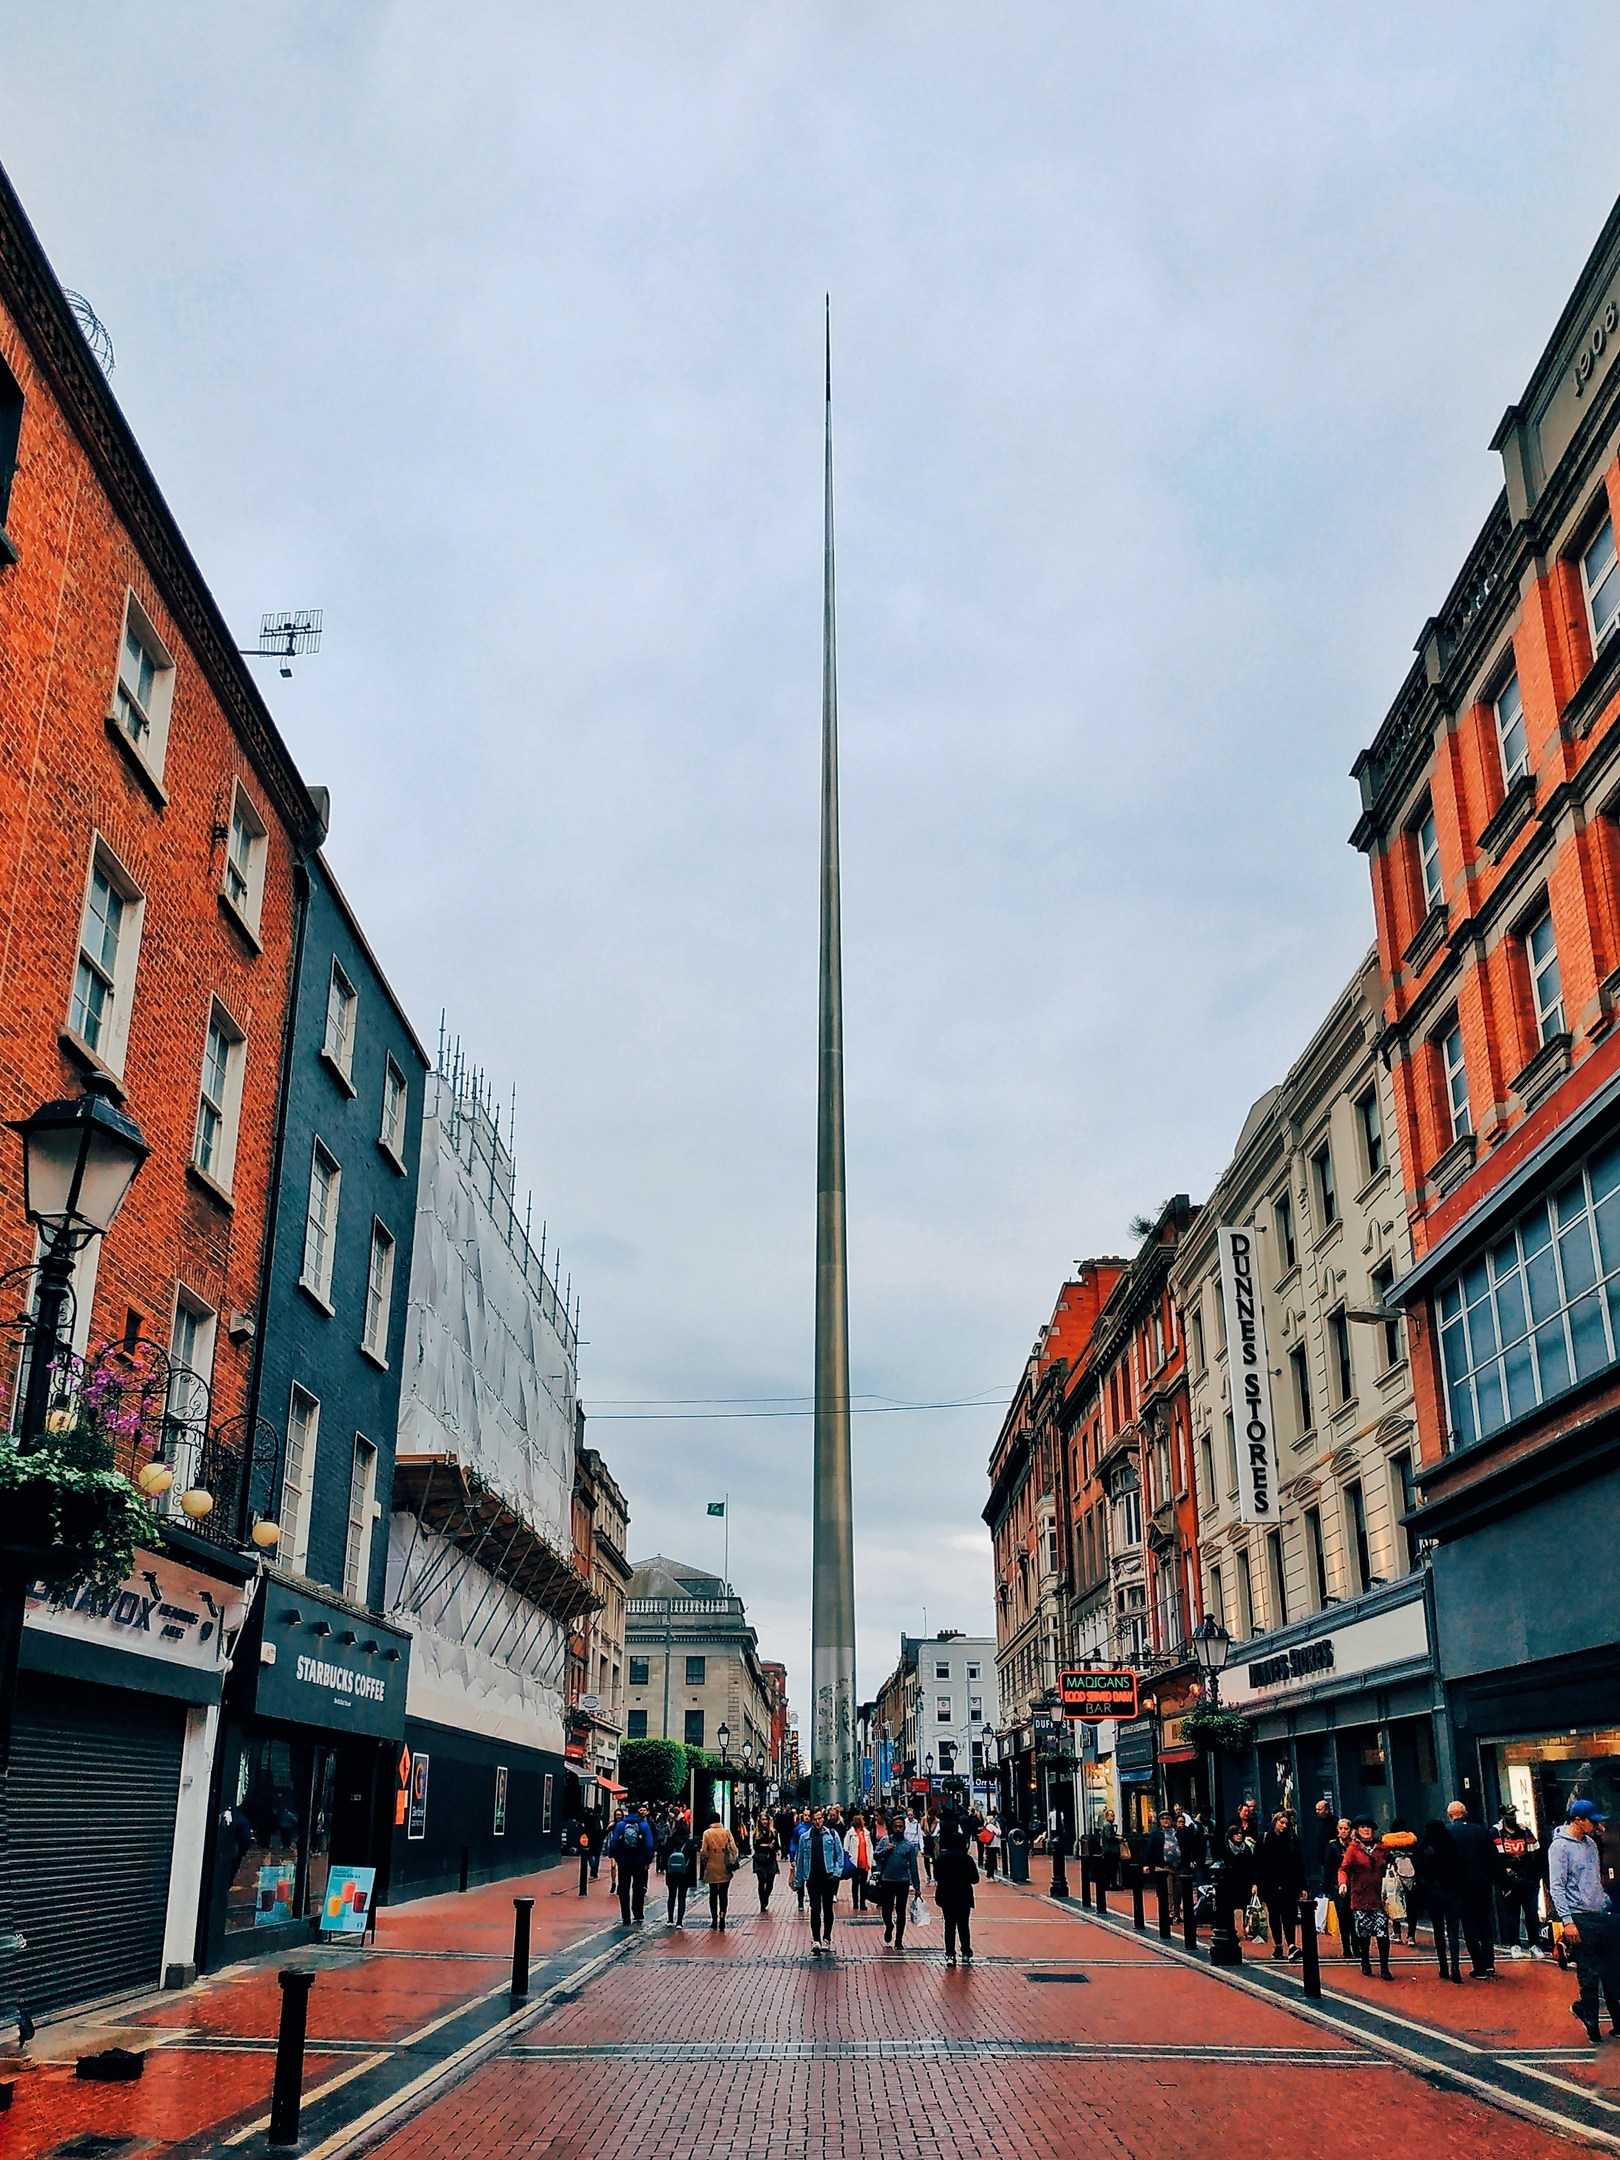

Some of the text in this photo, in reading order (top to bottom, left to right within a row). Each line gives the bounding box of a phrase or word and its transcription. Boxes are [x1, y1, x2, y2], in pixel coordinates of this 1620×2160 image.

[1574, 301, 1619, 398] 1908
[1230, 1233, 1269, 1514] DUNNES STORES
[296, 1654, 386, 1702] STARBUCKS COFFEE
[1066, 1676, 1130, 1689] MADIGANS
[1064, 1690, 1086, 1703] FOOD
[1086, 1690, 1112, 1703] SERVED
[1086, 1702, 1112, 1714] BAR
[1035, 1719, 1067, 1729] DUFFS
